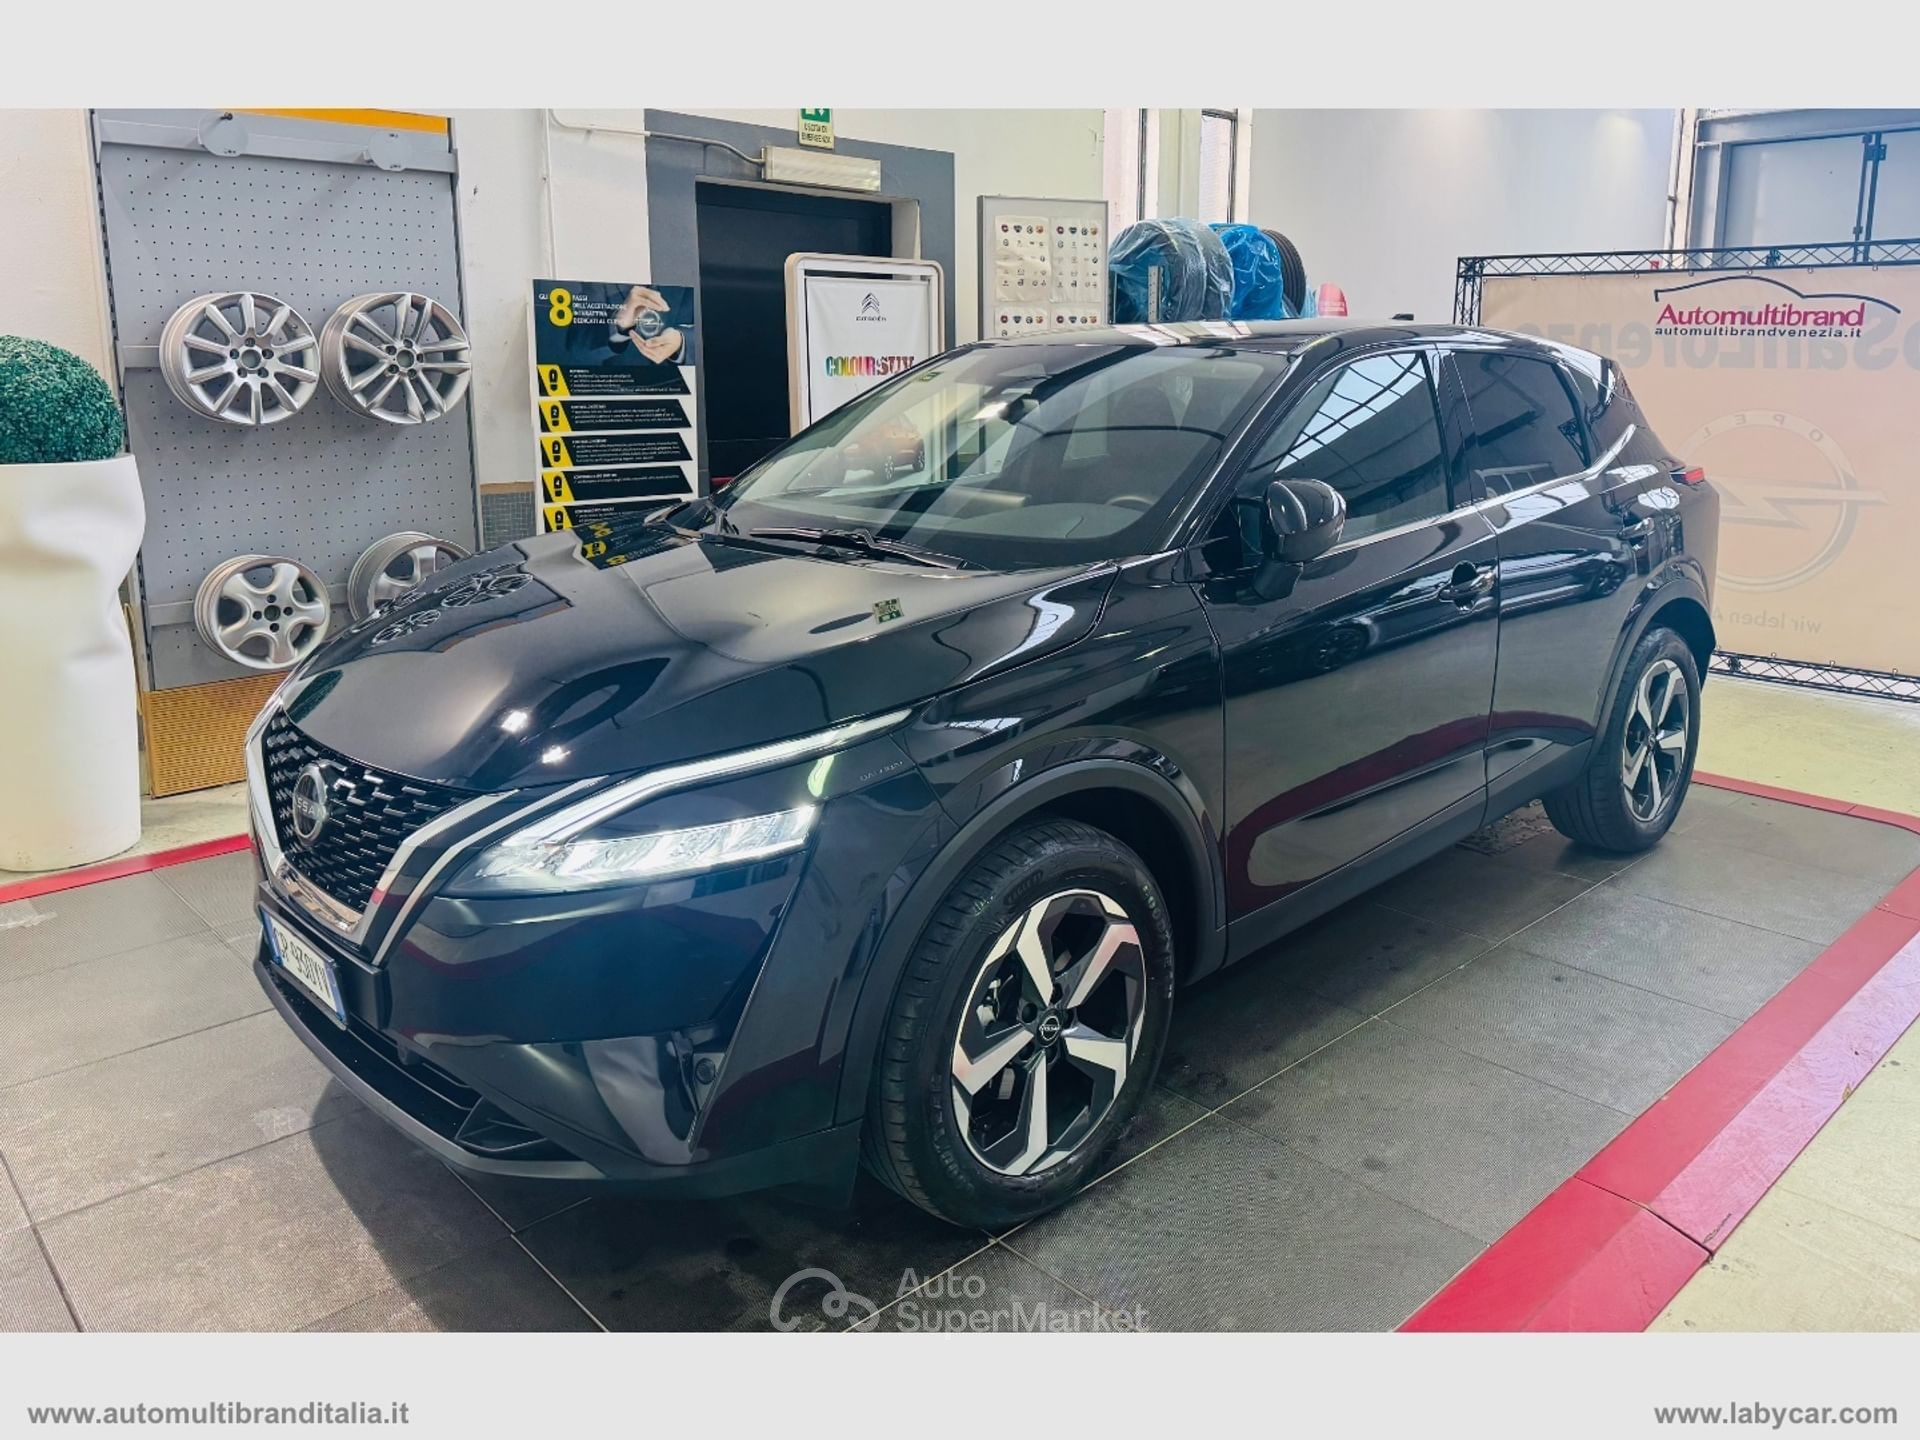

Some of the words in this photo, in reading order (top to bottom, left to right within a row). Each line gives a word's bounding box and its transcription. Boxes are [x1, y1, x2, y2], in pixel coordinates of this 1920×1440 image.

[549, 287, 573, 327] 8
[1656, 302, 1865, 327] Automultibrand
[1654, 326, 1862, 338] automultibrandvenezia.it
